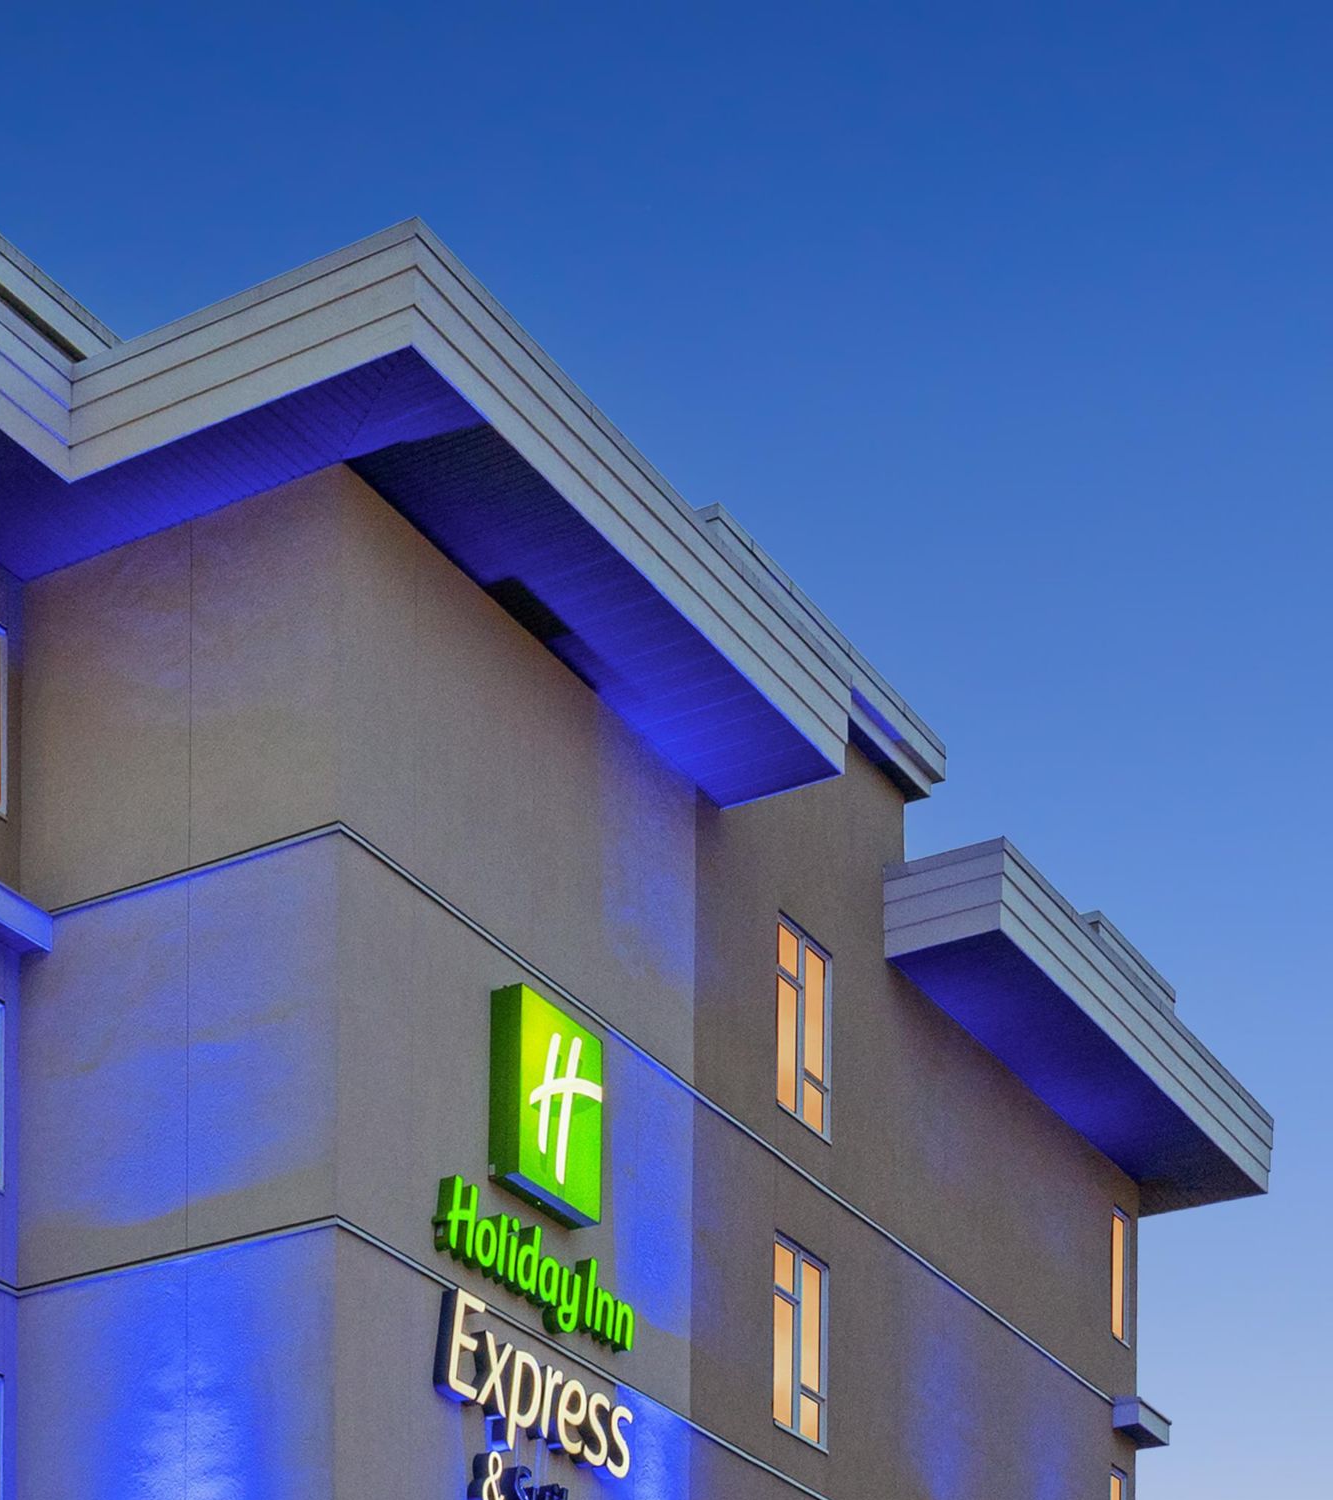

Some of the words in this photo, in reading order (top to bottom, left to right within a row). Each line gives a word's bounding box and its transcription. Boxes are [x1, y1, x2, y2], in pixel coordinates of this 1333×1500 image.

[443, 1173, 583, 1334] Holiday
[583, 1256, 635, 1353] Inn
[445, 1286, 635, 1480] Express
